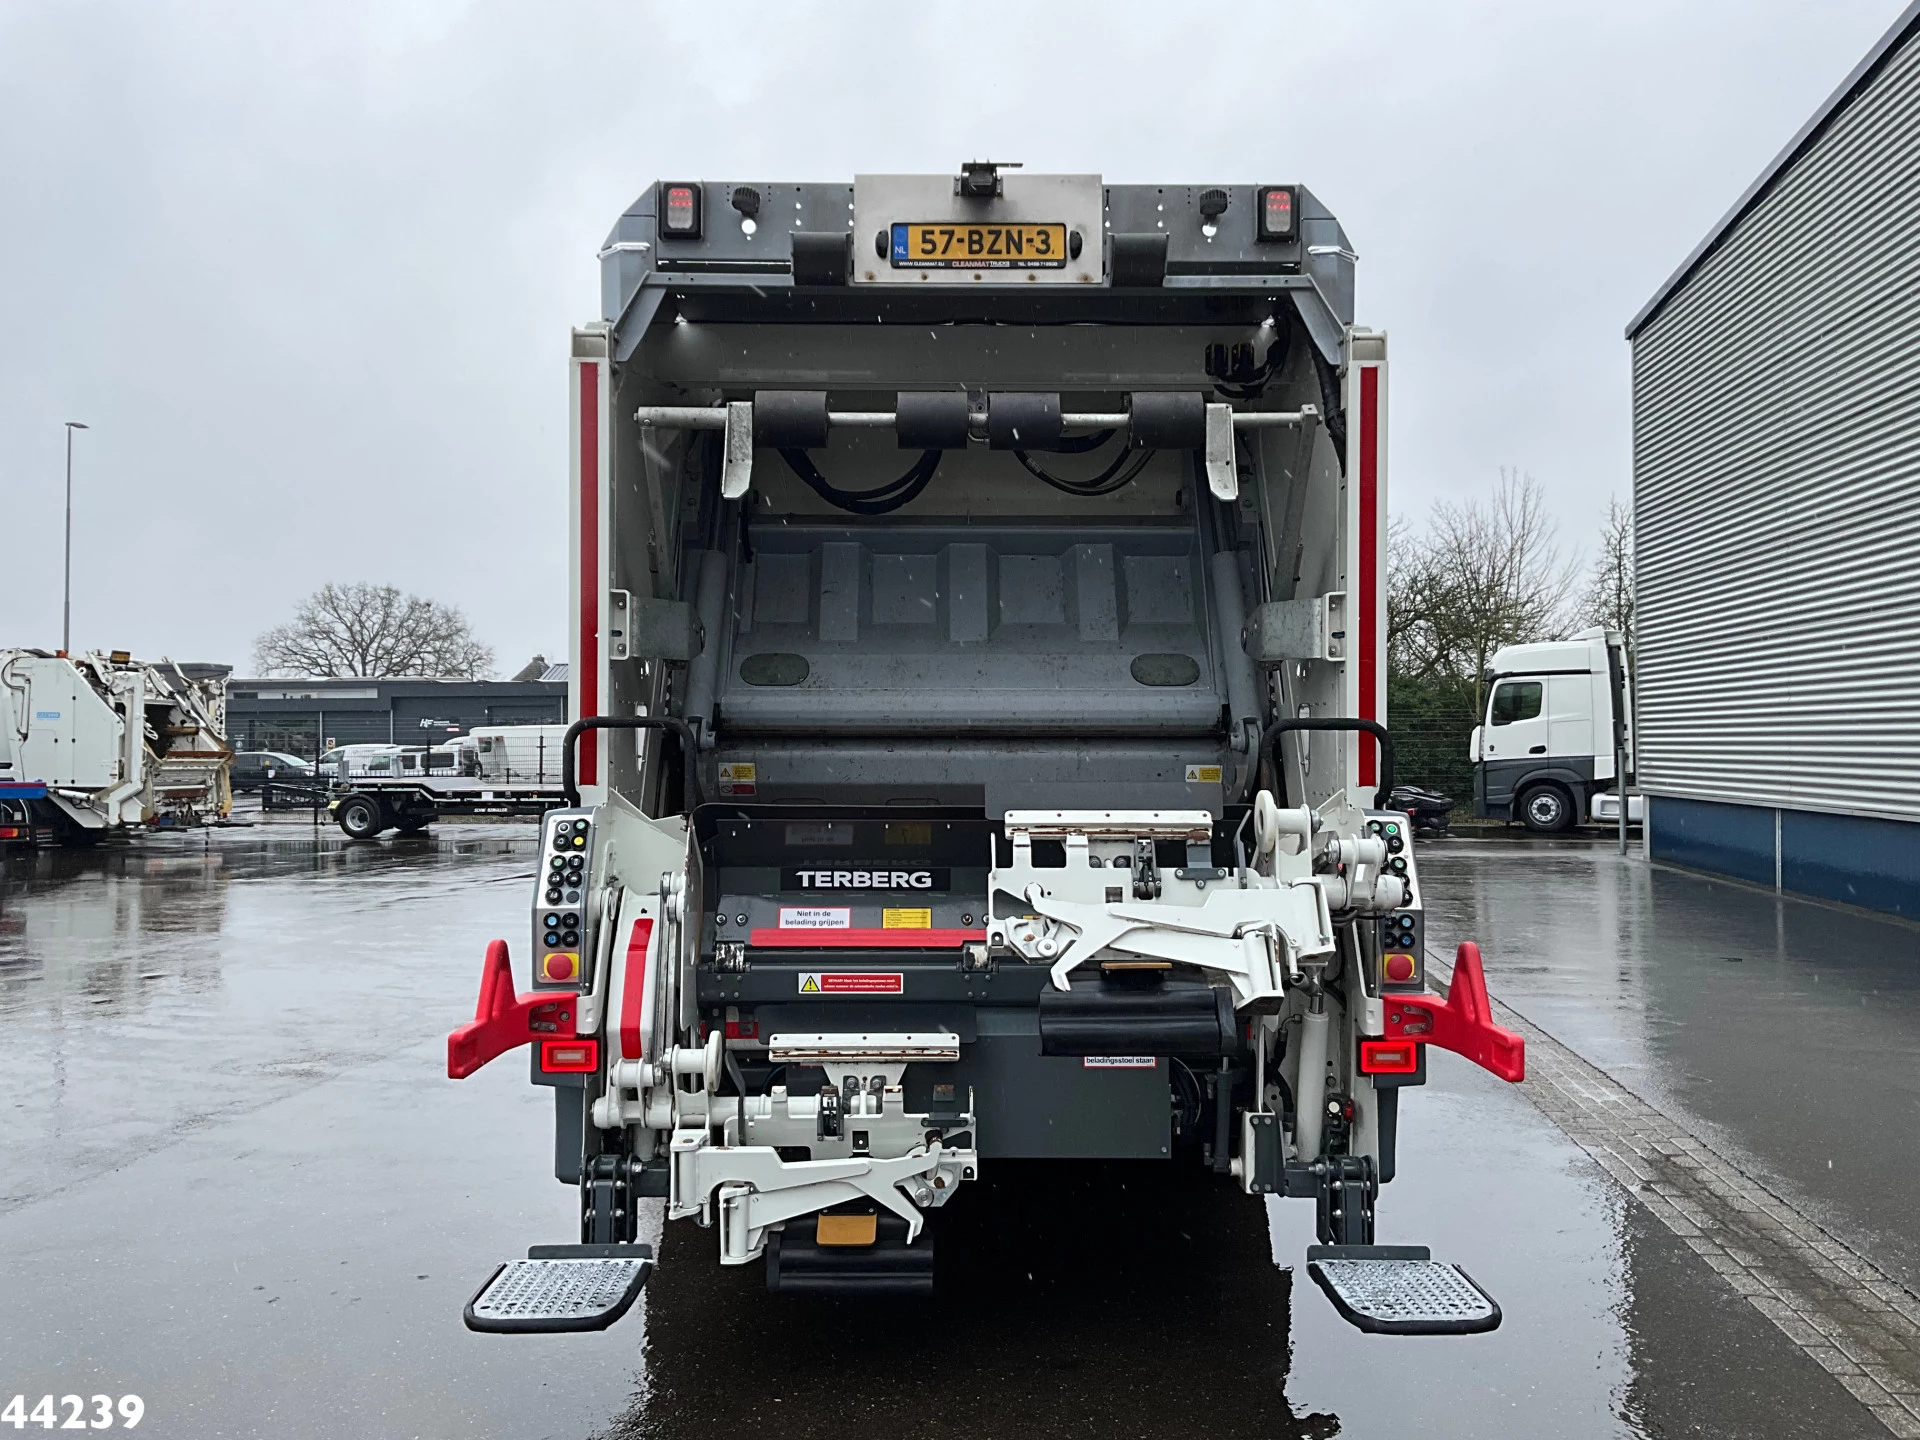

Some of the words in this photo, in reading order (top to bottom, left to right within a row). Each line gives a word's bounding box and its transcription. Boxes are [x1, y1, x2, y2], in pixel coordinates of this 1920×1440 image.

[894, 245, 907, 254] NL
[921, 229, 1051, 255] 57-BZN-3
[795, 870, 932, 888] TERBERG
[785, 918, 817, 926] belading
[818, 918, 844, 927] grijpen
[1086, 1057, 1135, 1065] beladingsstoel
